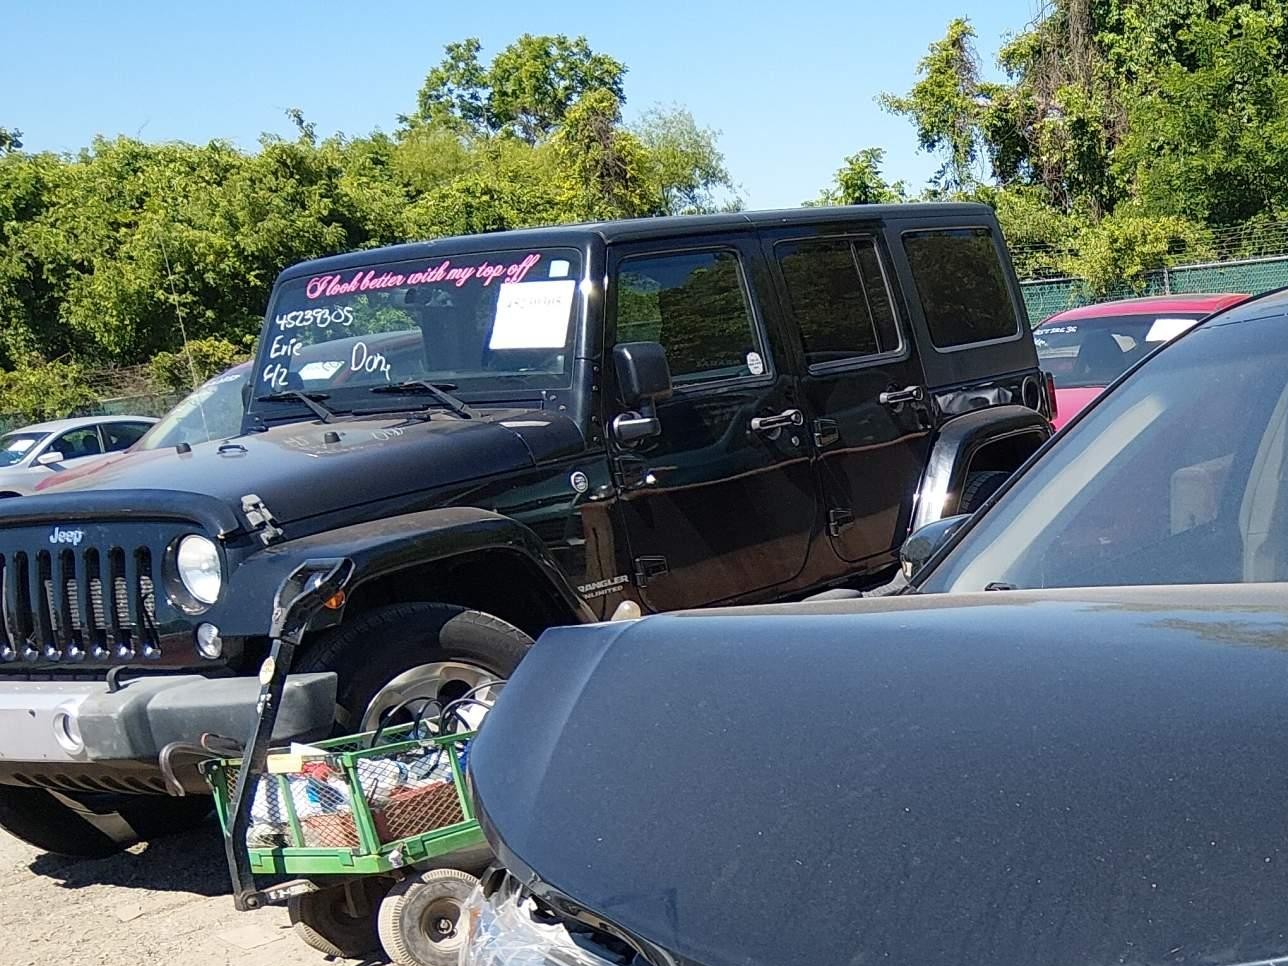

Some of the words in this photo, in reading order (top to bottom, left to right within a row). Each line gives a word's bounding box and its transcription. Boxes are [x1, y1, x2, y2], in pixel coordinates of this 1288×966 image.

[326, 272, 358, 296] look
[359, 269, 405, 291] better
[406, 260, 451, 285] with
[448, 266, 478, 287] my
[475, 261, 508, 287] top
[504, 253, 542, 284] off
[275, 307, 354, 331] 45239305
[48, 526, 84, 546] Jeep
[577, 574, 630, 593] RANGLER
[583, 585, 624, 600] NLIMITED
